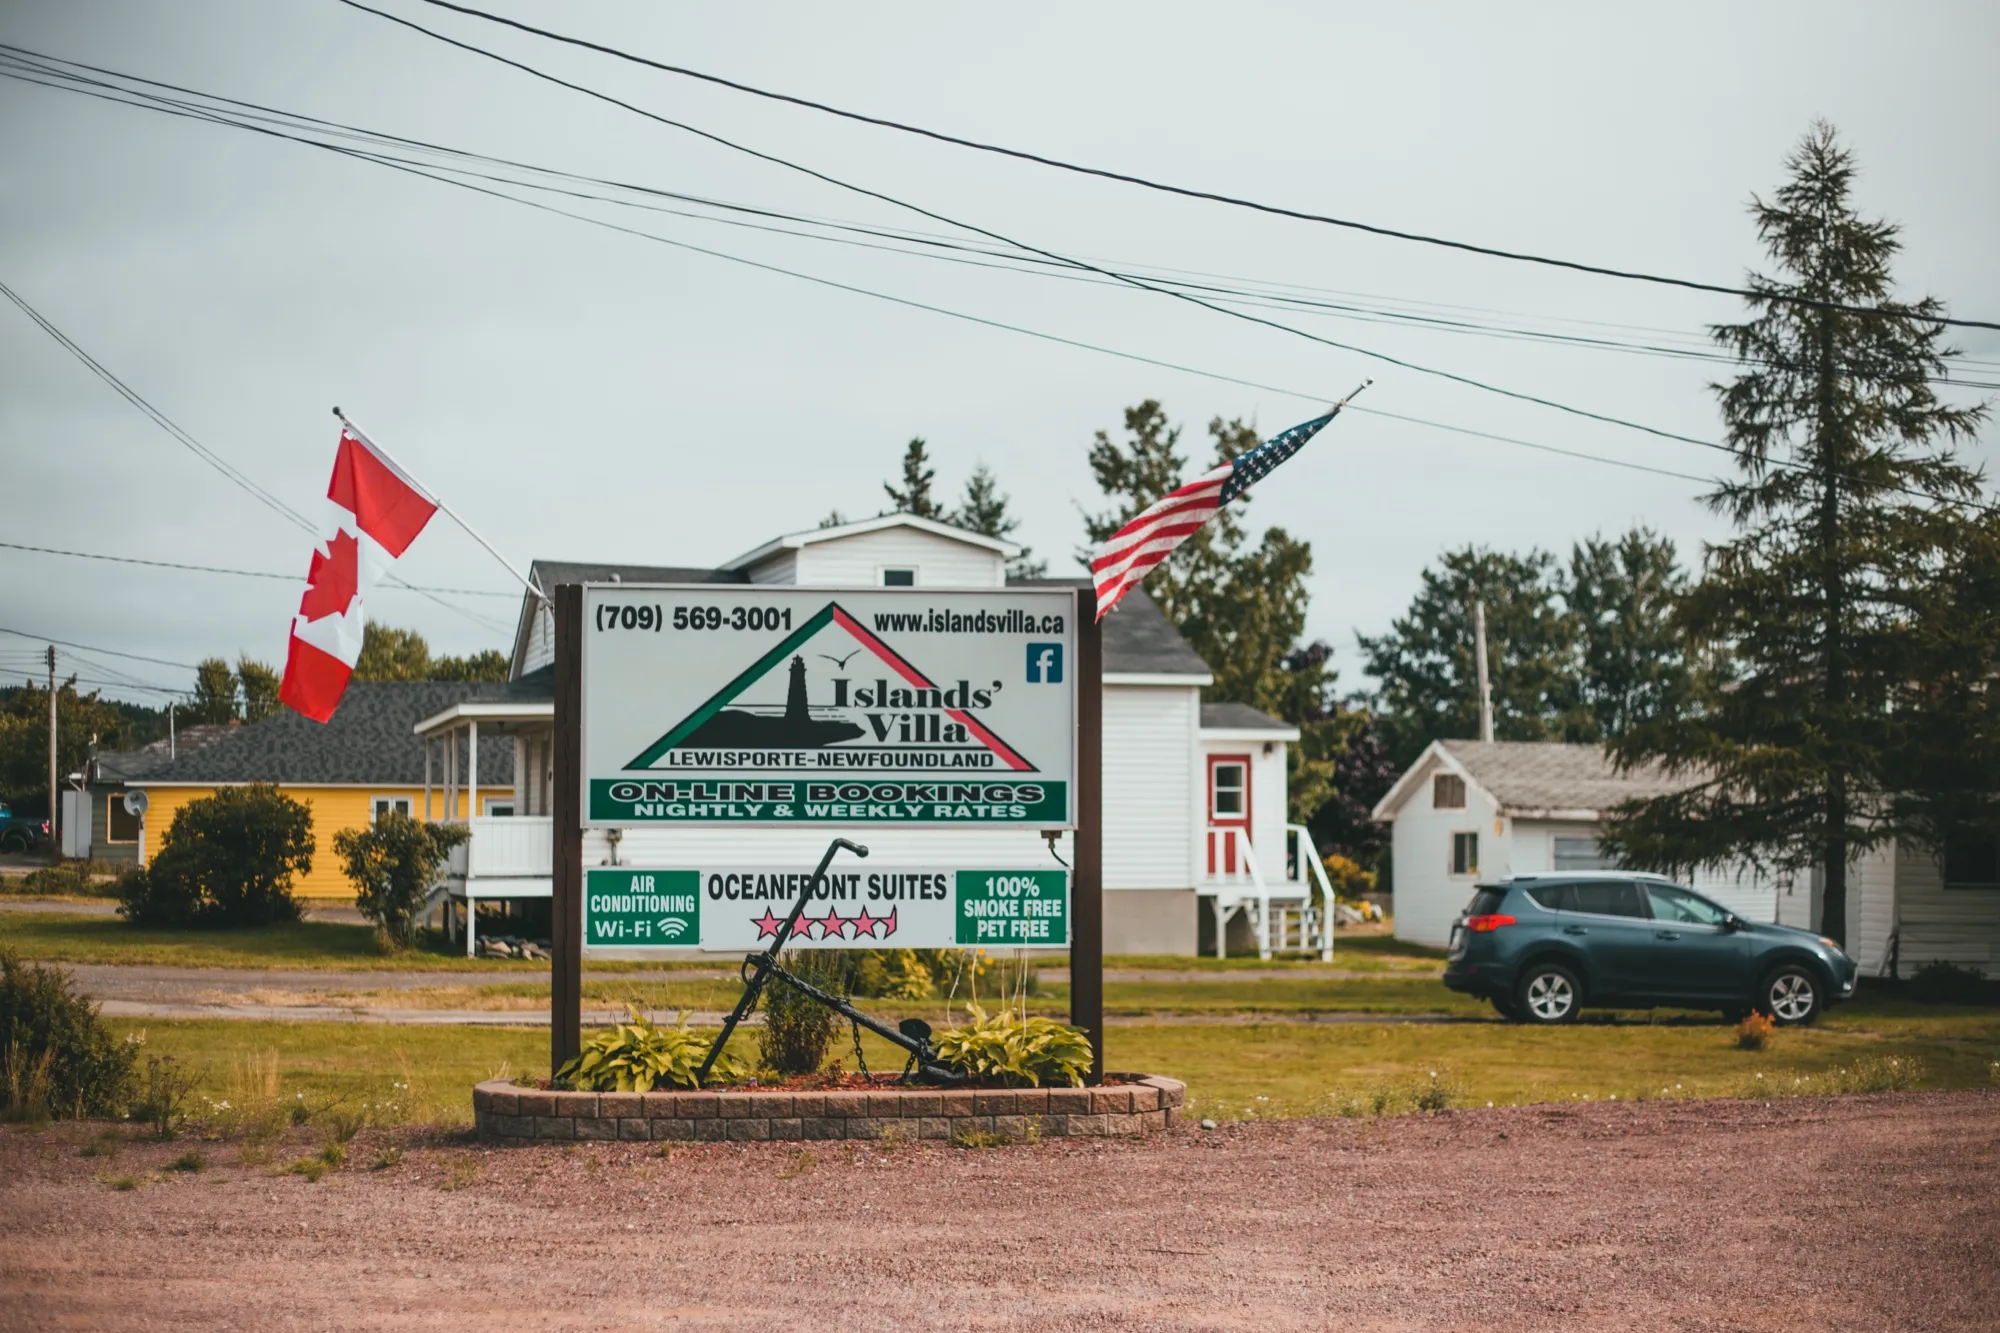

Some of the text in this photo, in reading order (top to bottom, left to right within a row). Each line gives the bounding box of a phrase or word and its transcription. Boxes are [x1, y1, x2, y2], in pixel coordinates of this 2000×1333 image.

[596, 604, 793, 632] (709) 569-3001
[874, 608, 1064, 634] www.islandsvilla.ca
[863, 714, 971, 743] Villa
[669, 751, 994, 767] LEWISPORTE-NEWFOUNDLAND
[609, 783, 1045, 803] ON-LINE BOOKINGS
[634, 804, 1028, 818] NIGHTLY & WEEKLY RATES
[630, 875, 655, 893] AIR
[867, 873, 947, 900] SUITES
[985, 876, 1041, 898] 100%
[591, 895, 695, 913] CONDITIONING
[964, 899, 1062, 917] SMOKE FREE
[594, 920, 652, 938] Wi-Fi
[977, 919, 1050, 938] PET FREE
